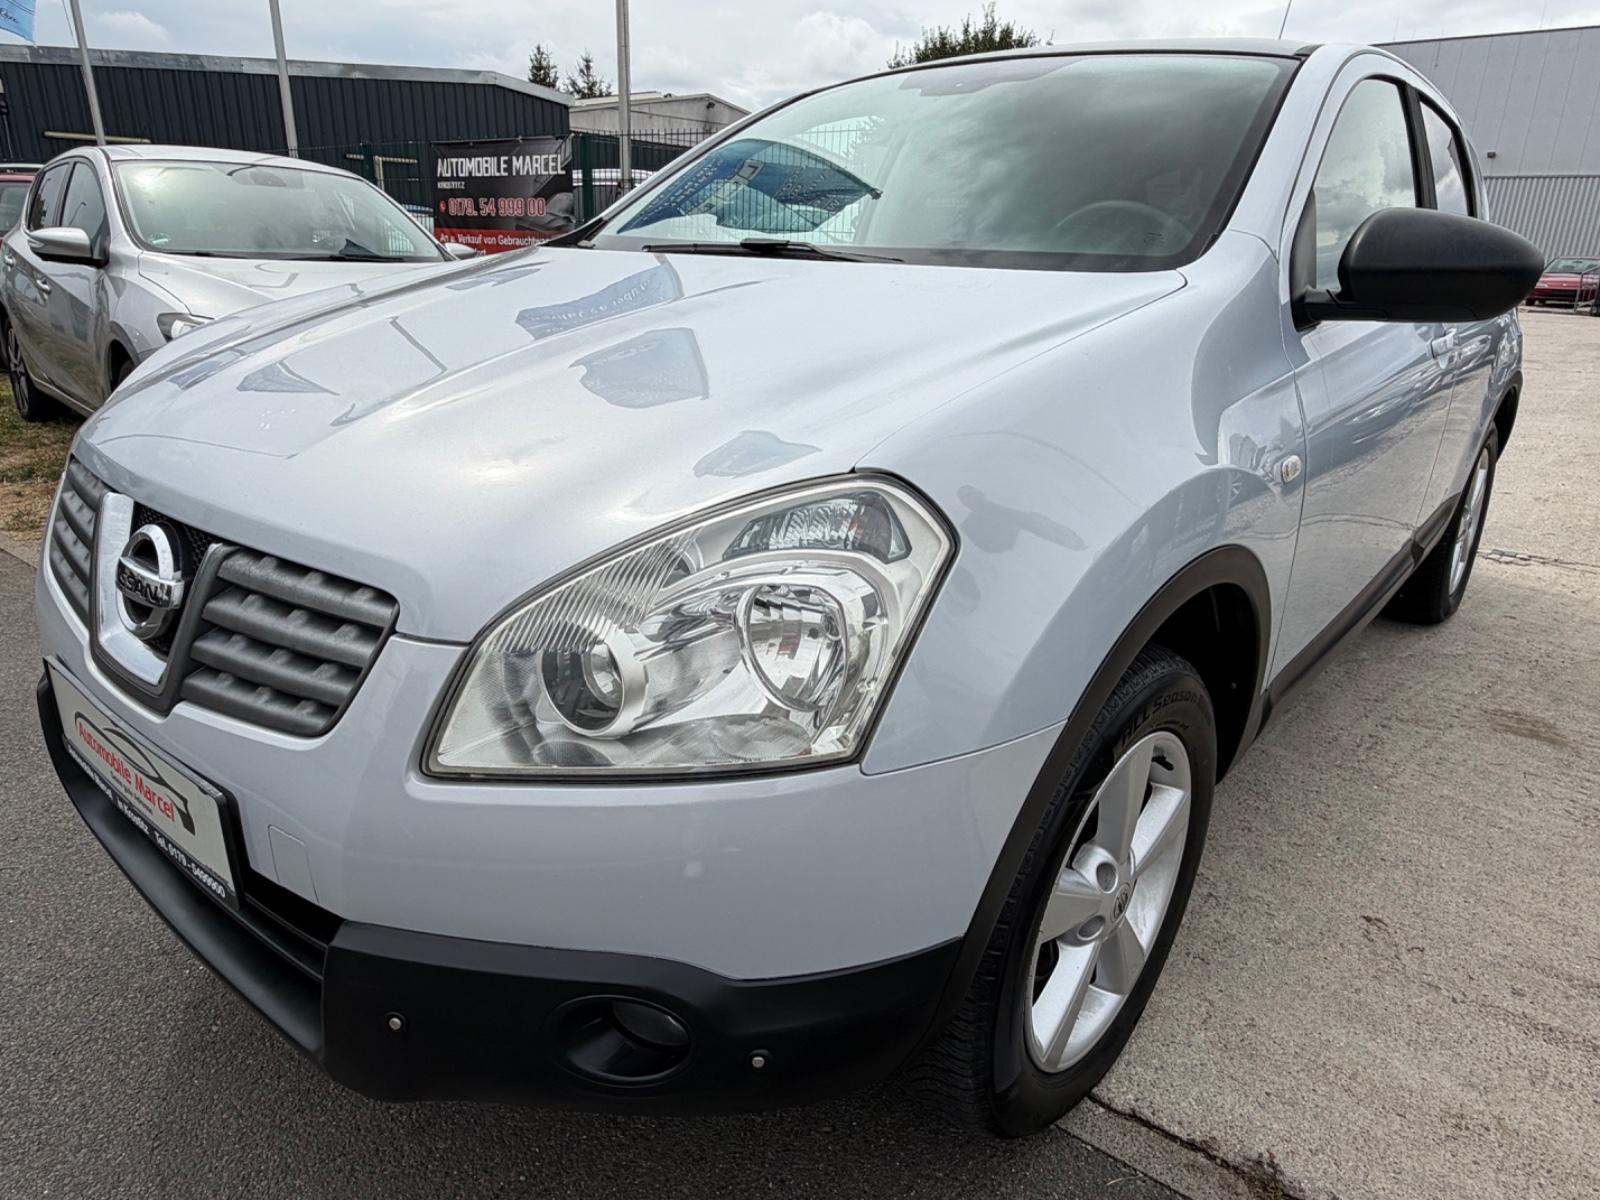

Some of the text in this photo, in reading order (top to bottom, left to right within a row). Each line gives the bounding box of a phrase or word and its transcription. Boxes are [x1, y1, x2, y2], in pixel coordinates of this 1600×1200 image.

[437, 154, 566, 177] AUTOMOBILE MARCEL
[479, 197, 496, 217] 54
[498, 198, 525, 217] 999
[527, 198, 546, 217] 00
[457, 233, 481, 245] Verkauf
[483, 236, 496, 245] von
[79, 721, 176, 822] Automobile Marcel
